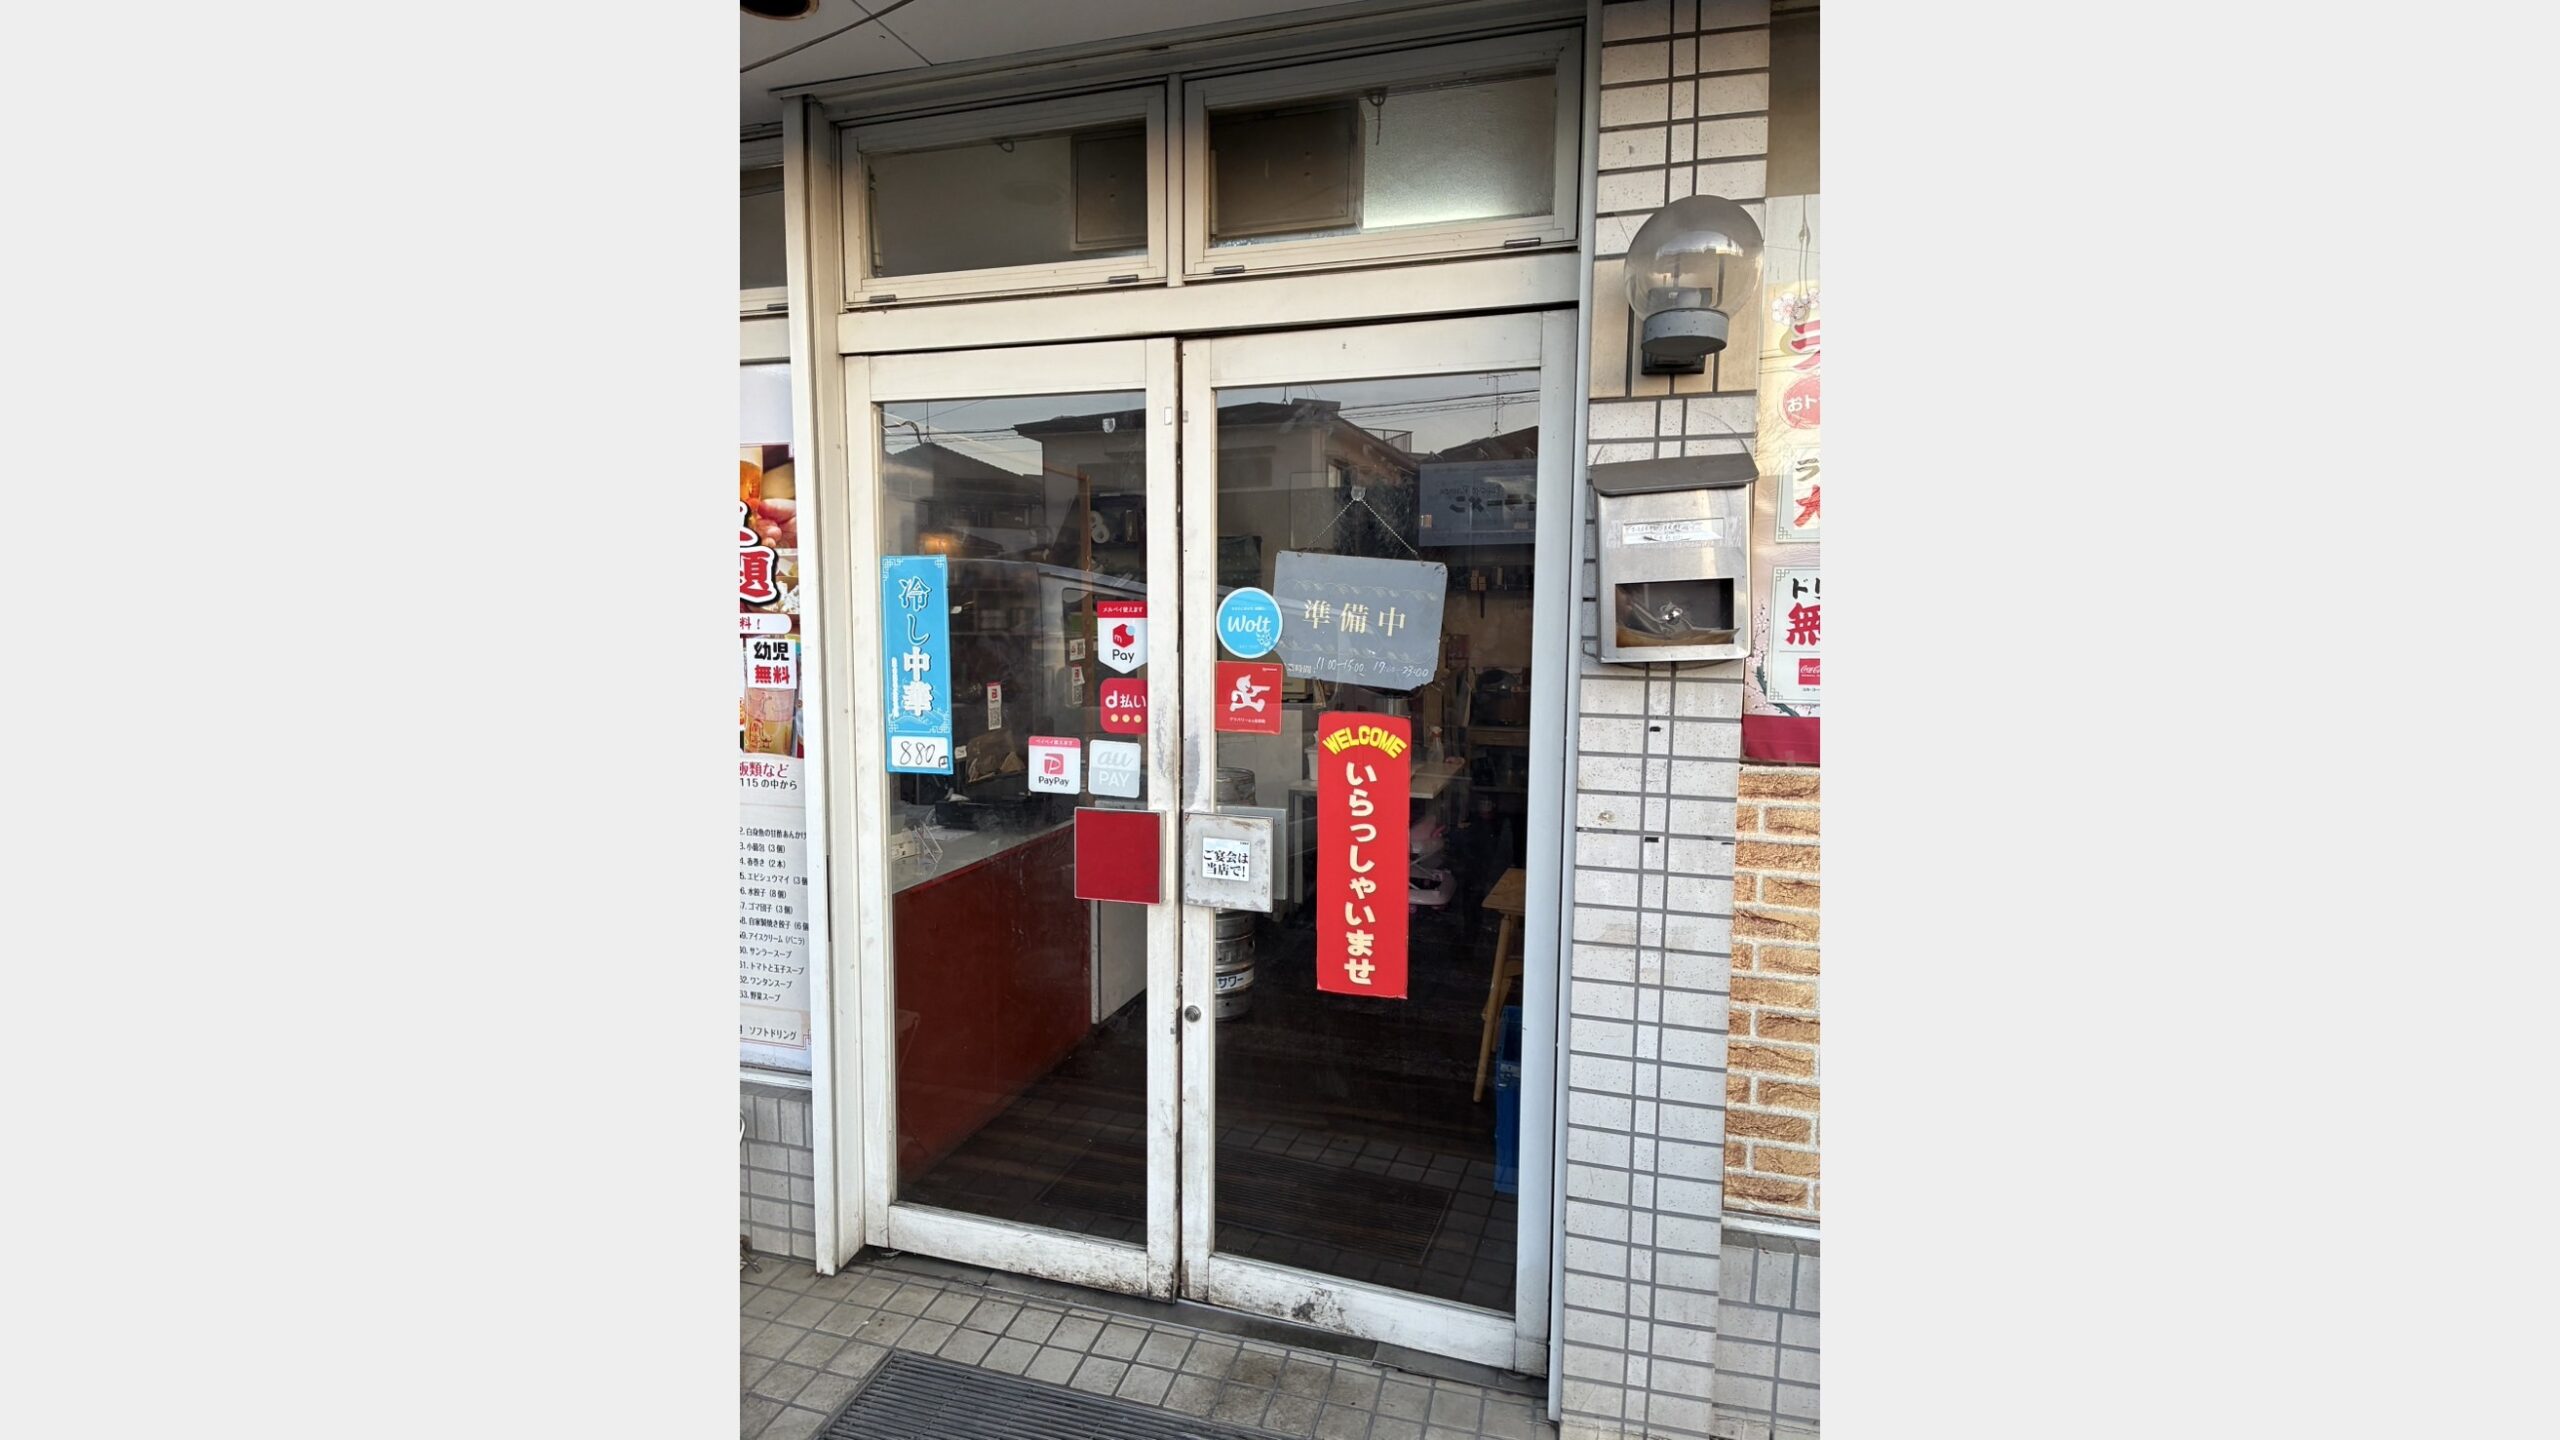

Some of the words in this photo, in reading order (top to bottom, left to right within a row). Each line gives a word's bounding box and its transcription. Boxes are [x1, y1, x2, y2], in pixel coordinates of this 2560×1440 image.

[1227, 615, 1271, 633] Wolt
[1303, 599, 1405, 637] 準備中
[753, 641, 790, 661] 幼児
[1112, 648, 1135, 663] Pay
[754, 665, 791, 685] 無料
[1105, 691, 1147, 709] d払い
[1322, 725, 1408, 759] WELCOME
[1038, 776, 1069, 787] PayPay
[1099, 772, 1130, 787] PAY
[1207, 862, 1246, 877] 当店で!
[1344, 761, 1377, 986] いらっしゃいませ
[1218, 975, 1244, 989] サワー
